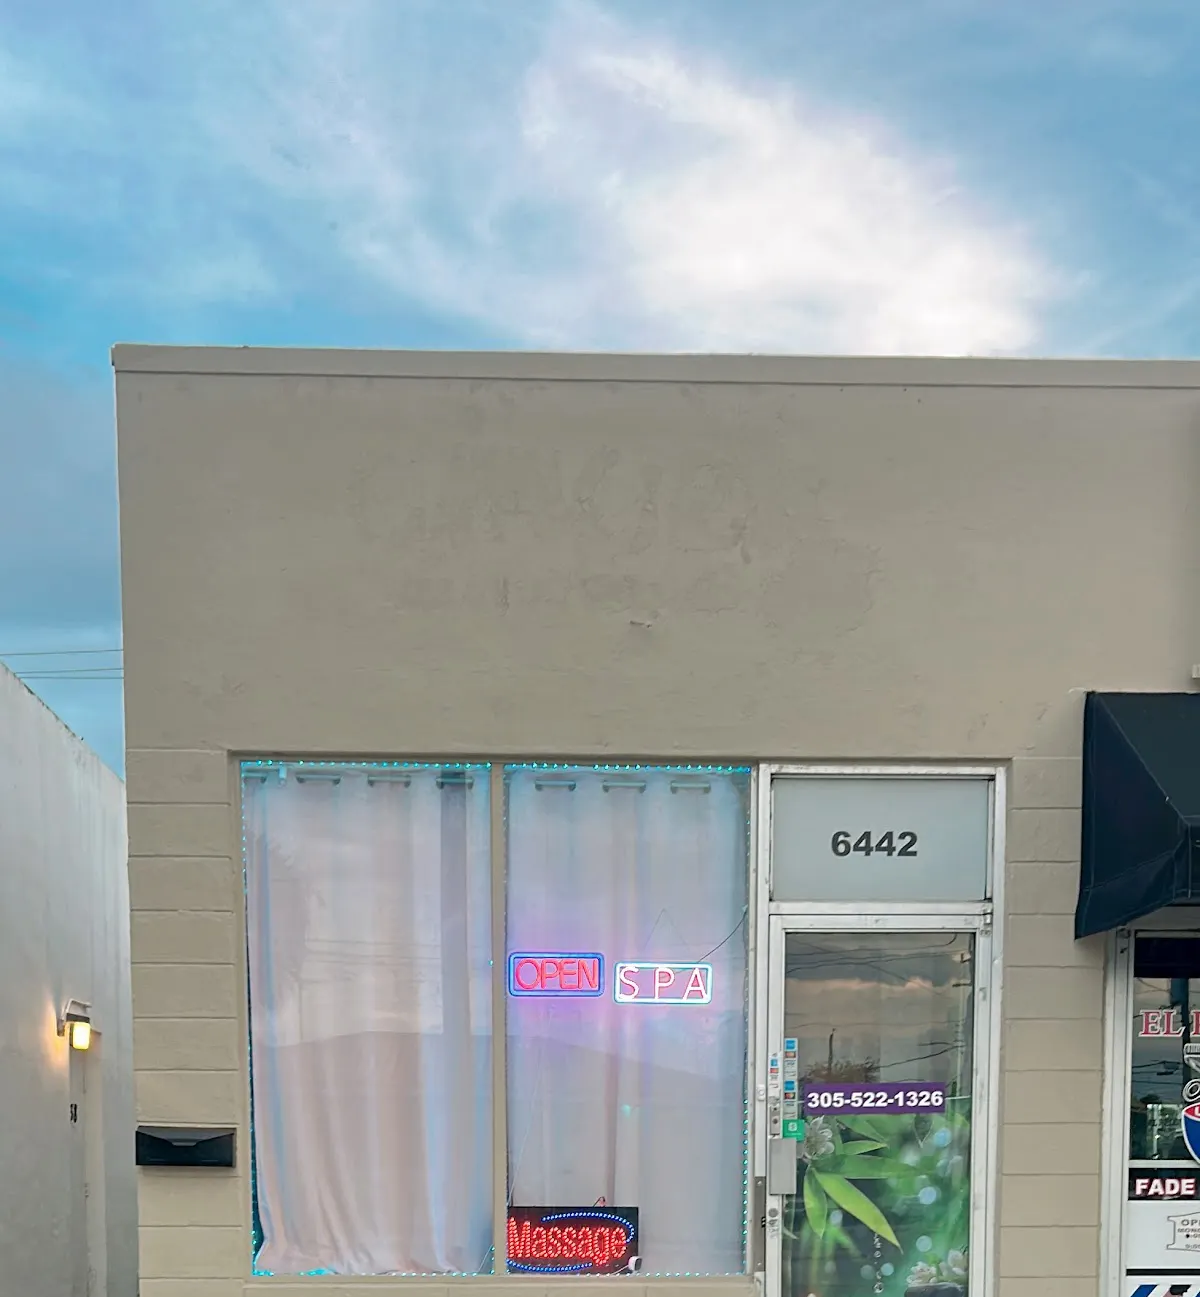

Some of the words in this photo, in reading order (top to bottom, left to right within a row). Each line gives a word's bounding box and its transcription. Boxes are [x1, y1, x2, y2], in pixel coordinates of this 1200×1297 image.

[831, 830, 918, 857] 6442
[515, 958, 599, 989] OPEN
[618, 965, 708, 1000] SPA
[1138, 1009, 1186, 1037] EL
[806, 1090, 944, 1108] 305-522-1326
[1135, 1178, 1196, 1196] FADE
[507, 1216, 628, 1266] Massage
